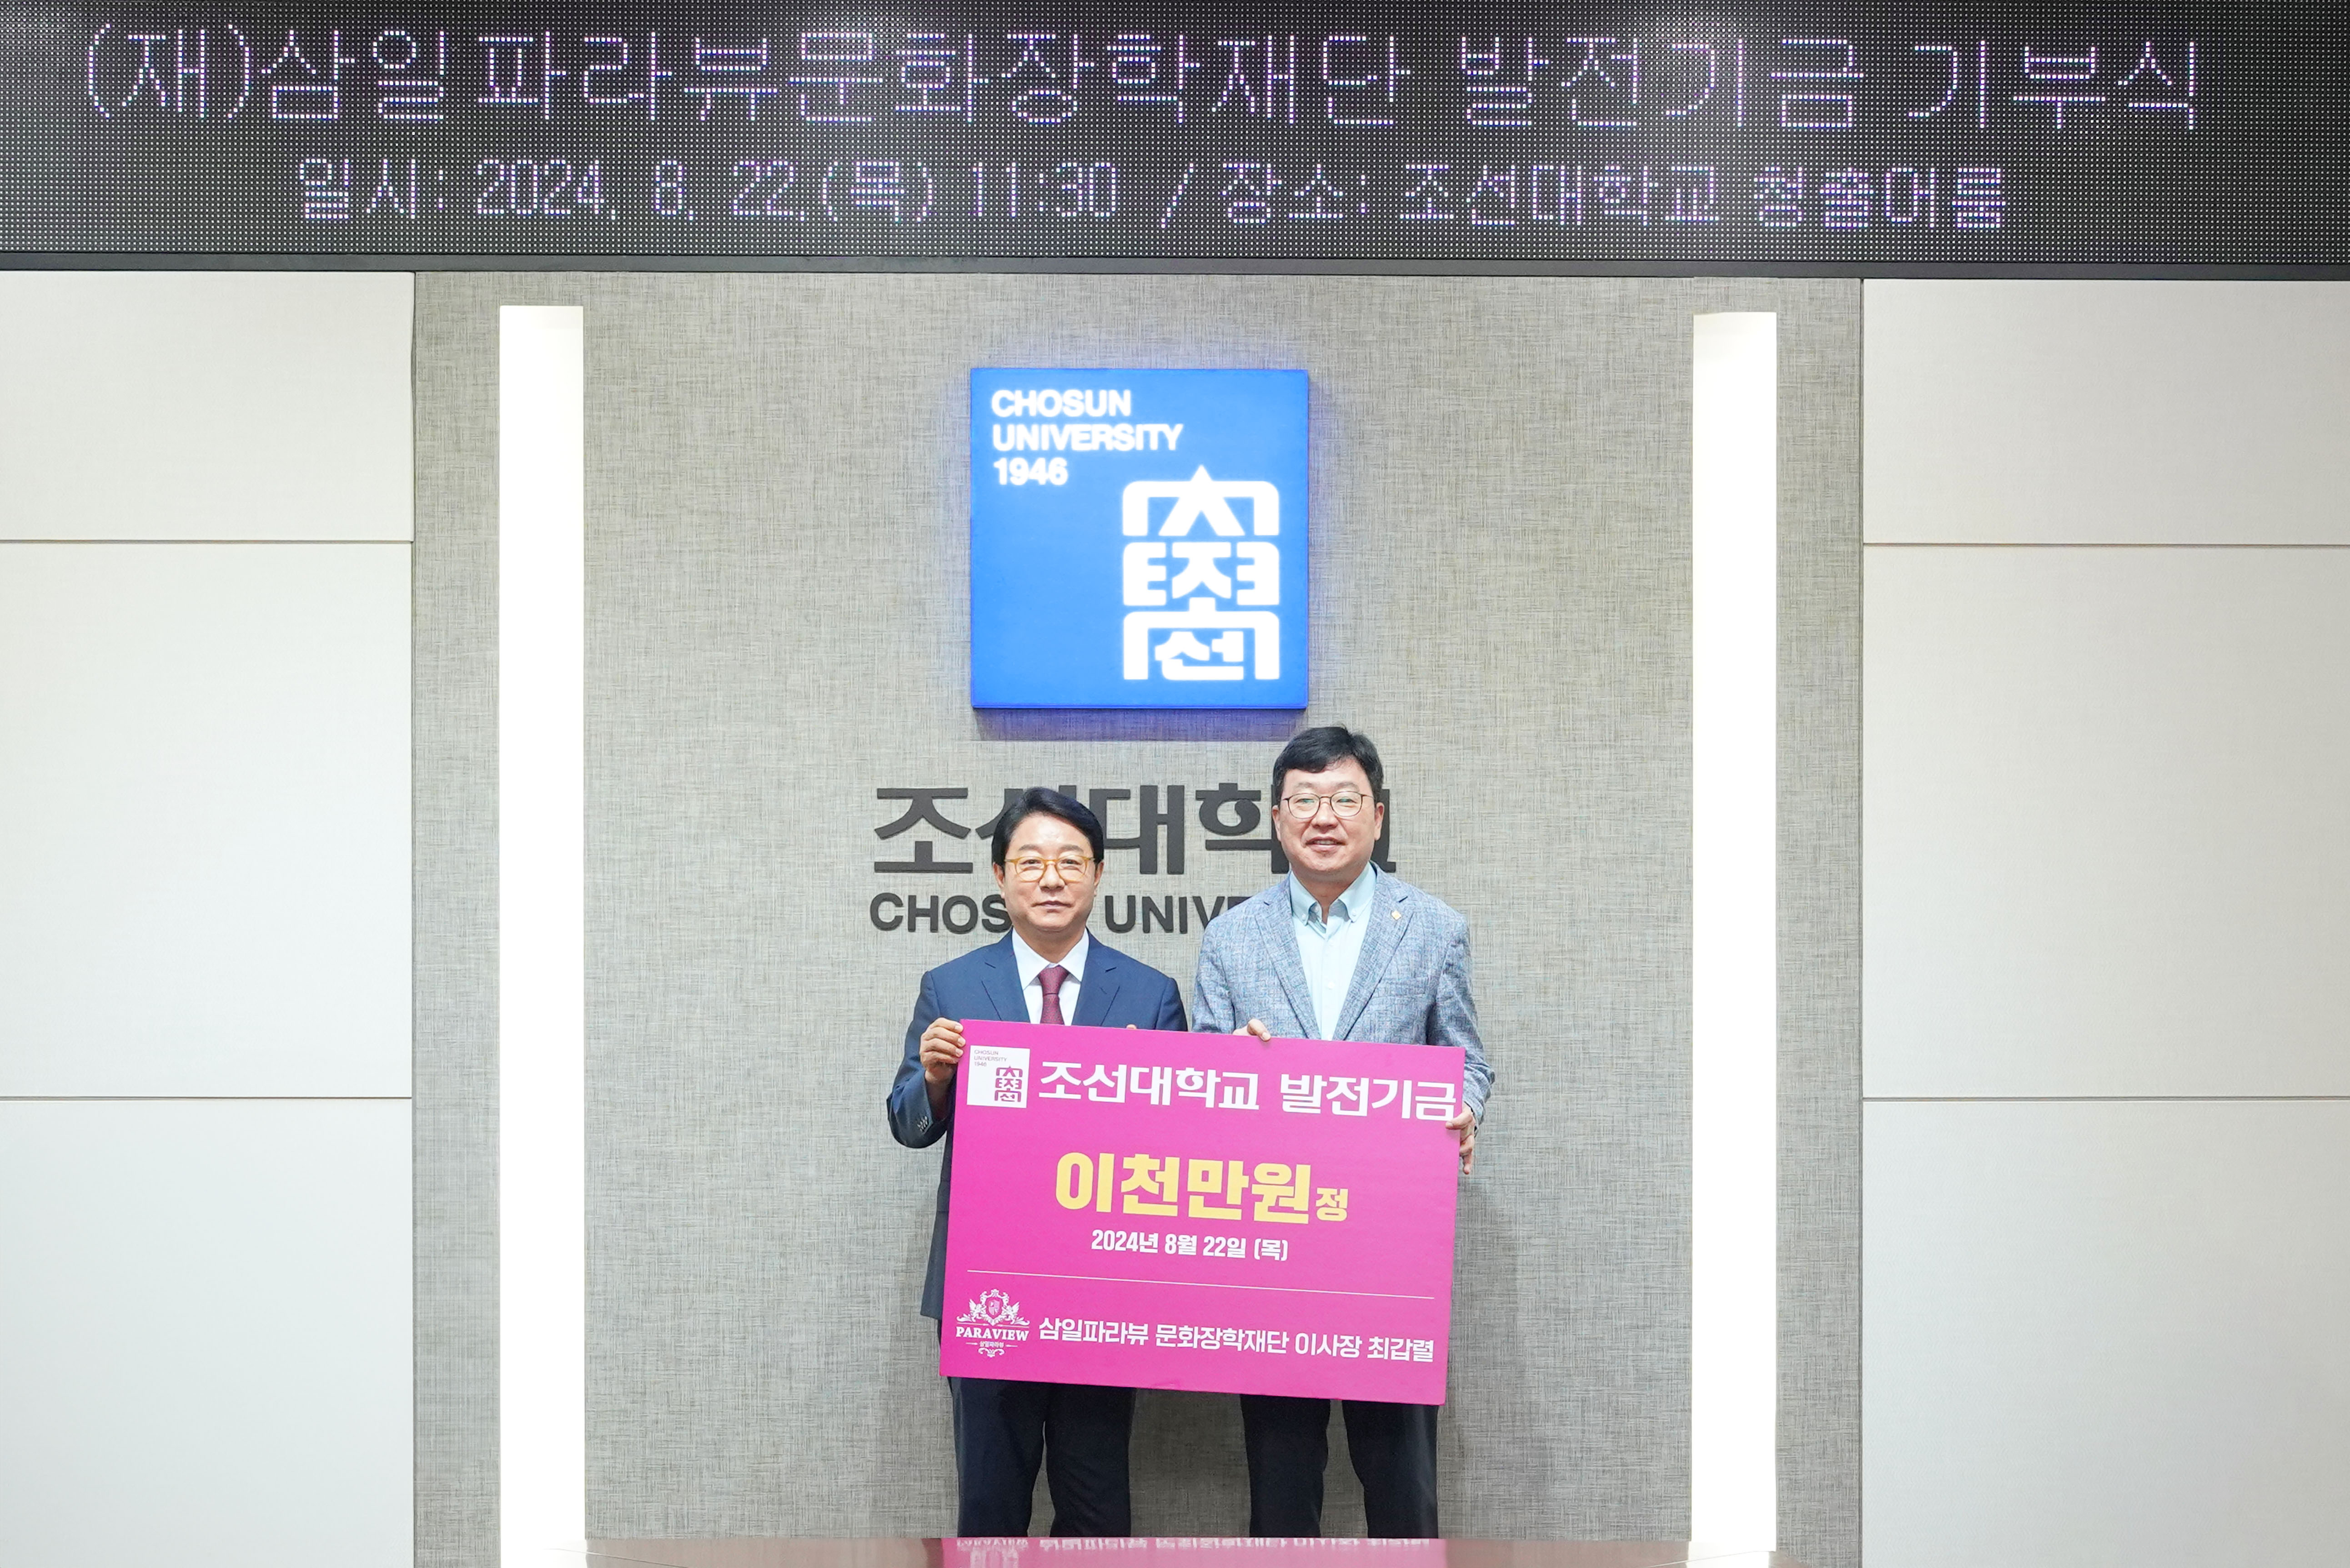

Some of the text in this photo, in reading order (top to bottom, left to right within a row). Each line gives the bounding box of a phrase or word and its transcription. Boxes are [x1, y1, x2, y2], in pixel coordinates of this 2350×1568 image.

[1461, 36, 1864, 127] 발전기금
[1908, 40, 2195, 130] 기부식
[299, 158, 444, 220] 일시:
[963, 161, 1116, 218] 11:30
[1160, 163, 1194, 229] /
[1221, 163, 1366, 224] 장소:
[1399, 164, 1720, 226] 조선대학교
[991, 389, 1131, 417] CHOSUN
[992, 422, 1184, 452] UNIVERSITY
[993, 457, 1069, 486] 1946
[874, 783, 1396, 874] 조대학
[869, 892, 1013, 935] CHOS
[1039, 1061, 1456, 1121] 조선대학교 발전기금
[1091, 1229, 1289, 1261] 2024년 8월 22일 (목)
[955, 1326, 1030, 1341] PARAVIEW
[1039, 1317, 1435, 1362] 삼일파라뷰 문화장학재단 이사장 최갑렬
